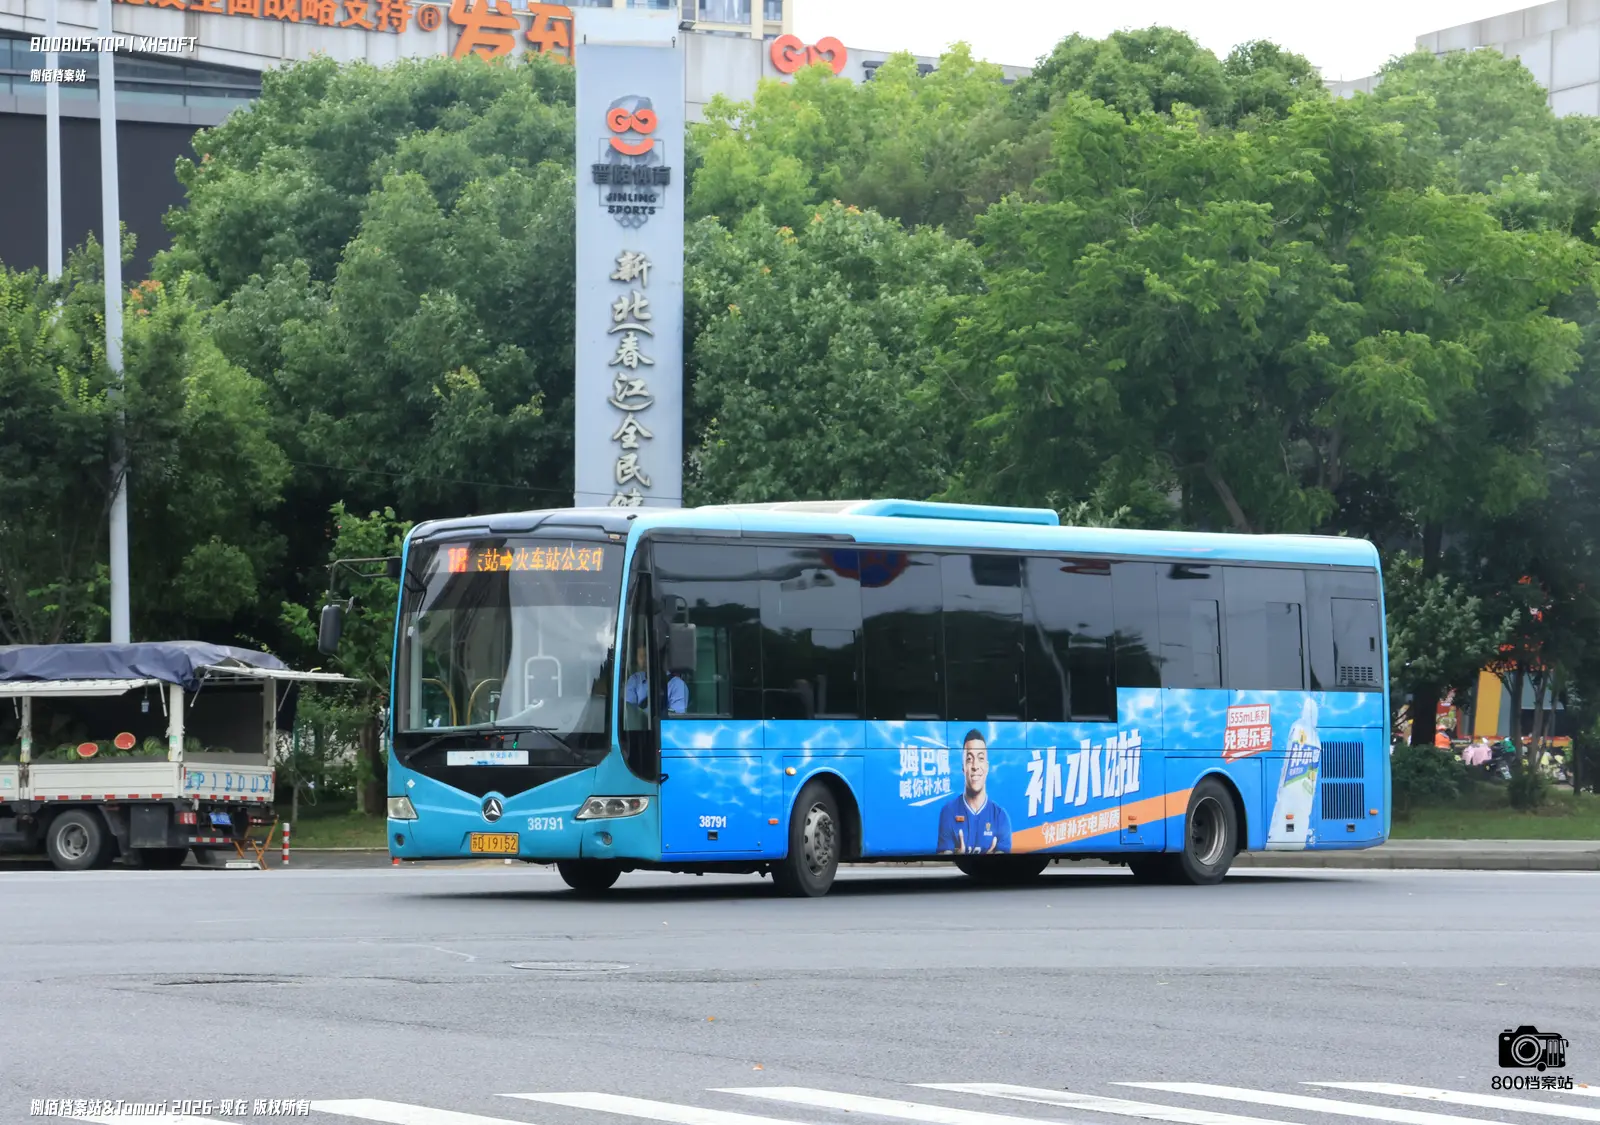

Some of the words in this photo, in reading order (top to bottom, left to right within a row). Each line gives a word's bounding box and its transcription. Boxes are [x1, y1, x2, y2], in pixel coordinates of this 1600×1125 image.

[606, 192, 657, 203] JINLING
[607, 205, 656, 215] SPORTS
[1222, 726, 1272, 757] 免费乐享
[1024, 728, 1142, 818] 补水啦
[527, 817, 564, 831] 38791
[699, 815, 727, 828] 38791
